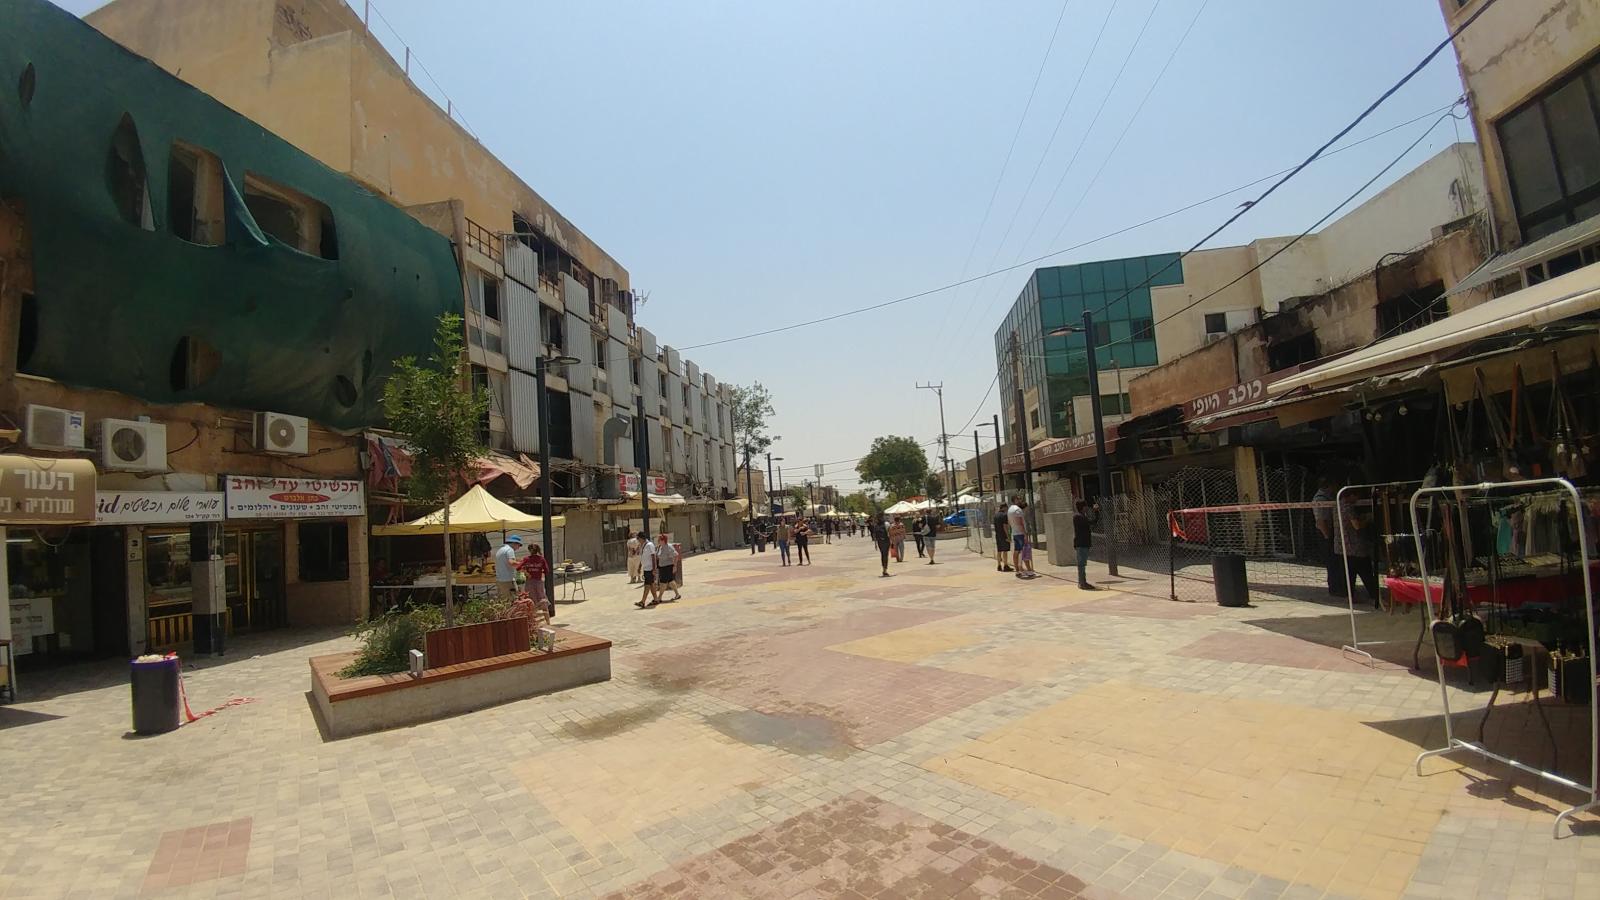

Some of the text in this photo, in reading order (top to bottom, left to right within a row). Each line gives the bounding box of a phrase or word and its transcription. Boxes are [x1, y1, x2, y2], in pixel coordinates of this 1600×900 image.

[1192, 380, 1262, 415] כוכב היופי
[14, 469, 74, 491] העור
[231, 478, 359, 492] תכשיטי עדי זהב
[97, 495, 120, 513] id
[120, 497, 162, 514] תכשיטים
[166, 496, 190, 513] שלום
